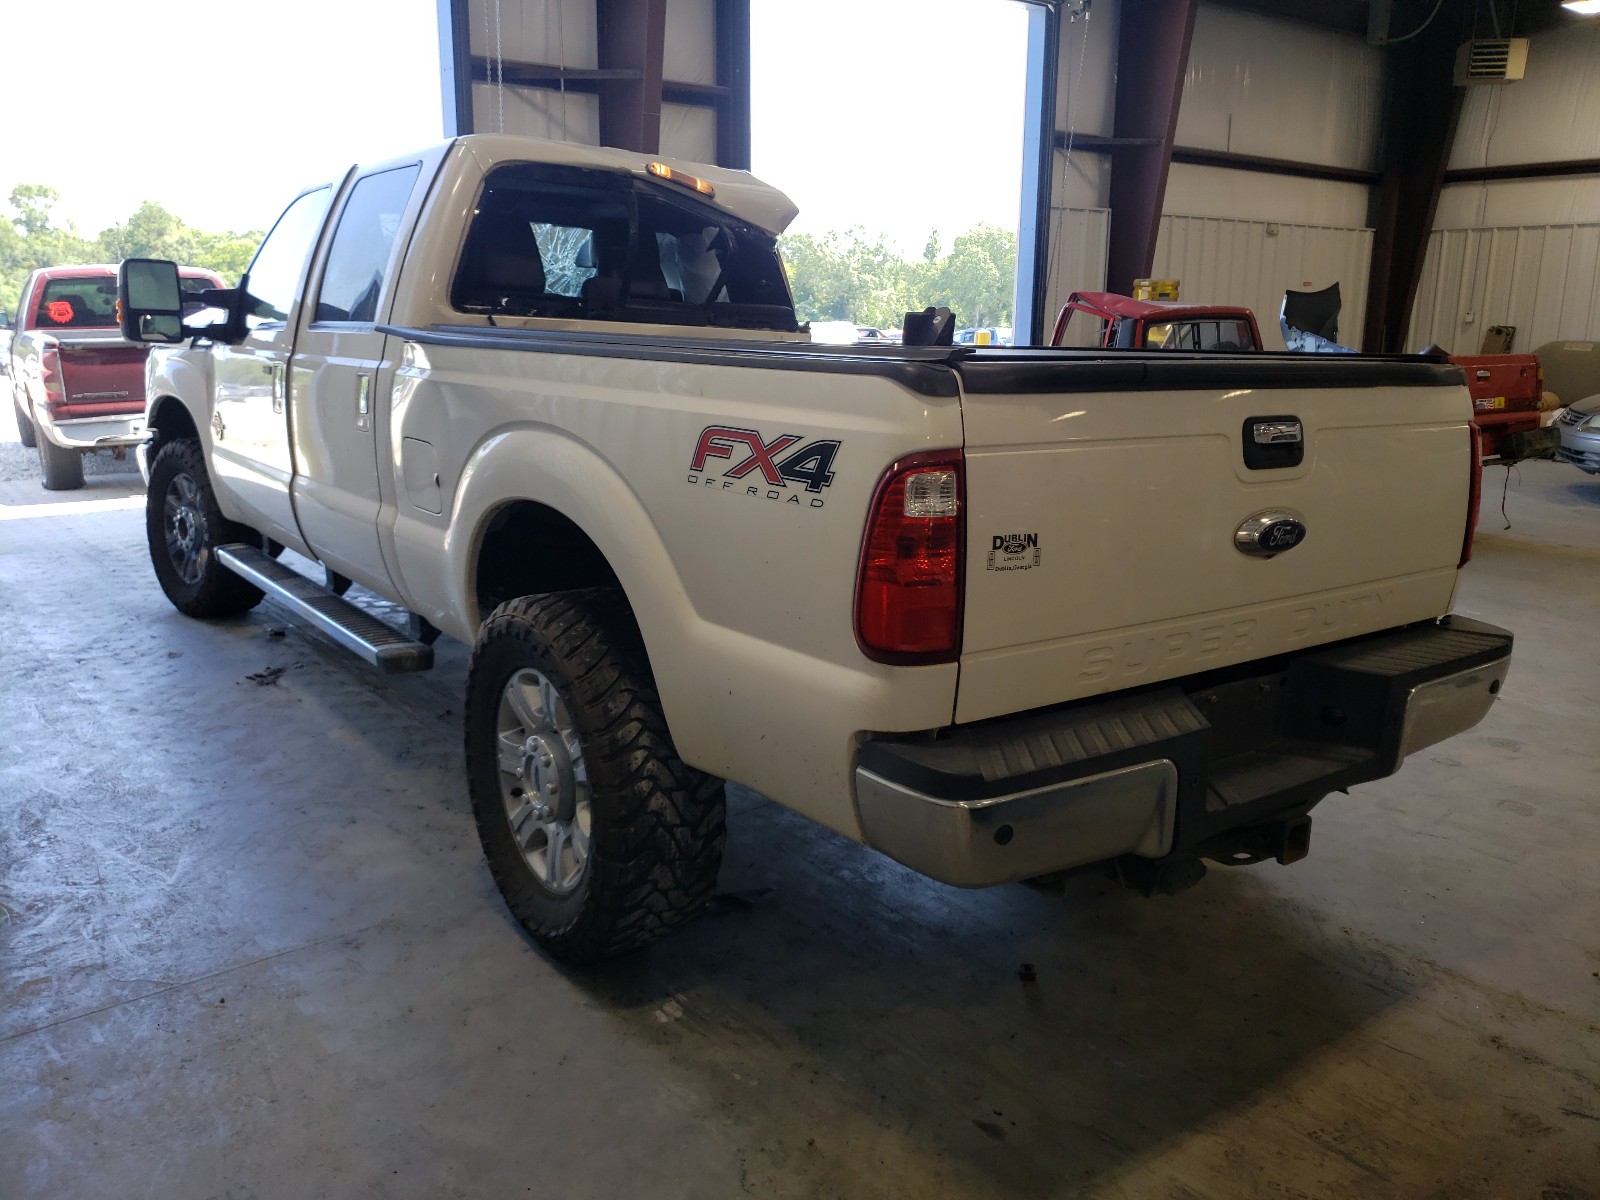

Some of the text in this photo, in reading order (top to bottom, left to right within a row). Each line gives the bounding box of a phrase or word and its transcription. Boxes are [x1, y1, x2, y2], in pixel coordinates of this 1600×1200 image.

[690, 425, 842, 493] FX4
[746, 486, 825, 508] ROAD
[992, 533, 1038, 550] DUBLIN
[1269, 525, 1299, 547] Ford
[1079, 590, 1395, 685] SUPER DUTY
